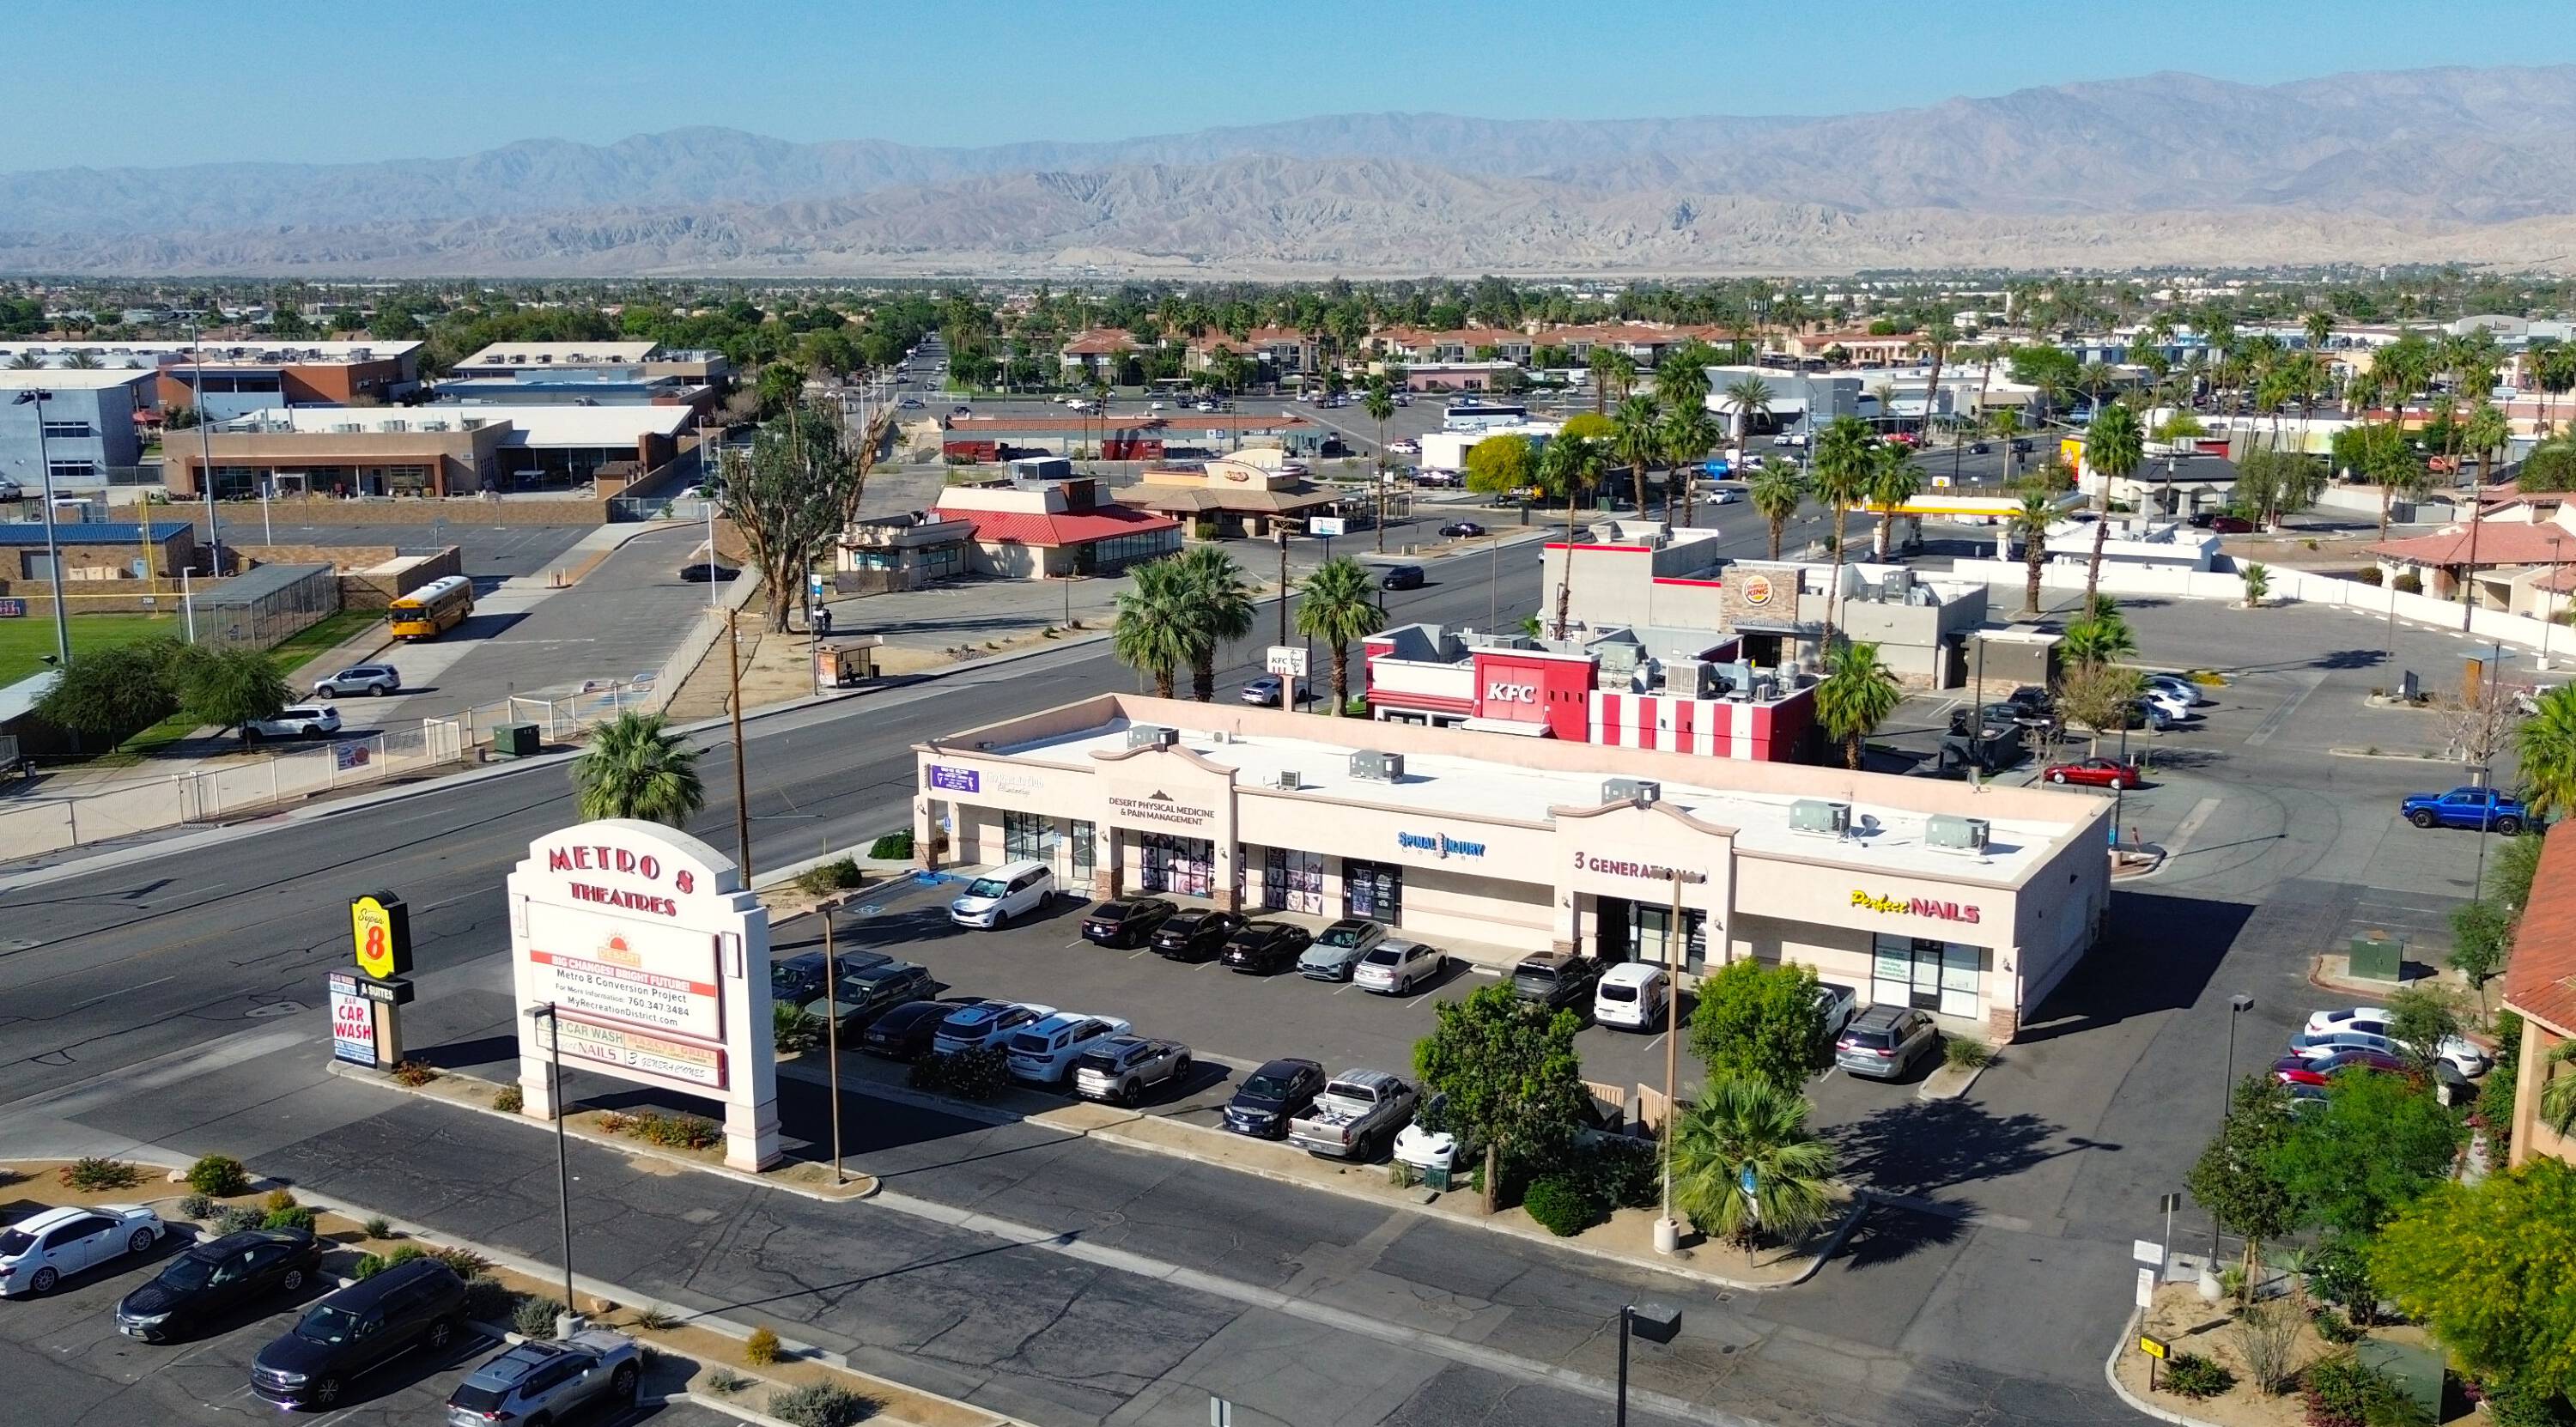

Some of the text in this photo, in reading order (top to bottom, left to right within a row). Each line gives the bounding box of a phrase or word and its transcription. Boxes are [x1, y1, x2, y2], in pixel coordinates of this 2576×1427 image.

[1487, 683, 1536, 704] KFC
[1109, 797, 1215, 818] DESERT PHYSICAL MEDICINE
[1127, 809, 1145, 818] PAIN
[1146, 811, 1203, 825] MANAGEMENT
[1398, 831, 1436, 850] SPINAL
[1443, 837, 1485, 857] INJURY
[550, 846, 694, 895] METRO 8
[1574, 851, 1585, 870] 3
[568, 881, 677, 917] THEATRES
[1850, 890, 1980, 924] Perfect NAILS
[358, 908, 384, 928] Super
[366, 926, 386, 961] 8
[551, 955, 690, 992] BIG CHANGES! BRIGHT FUTURE!
[361, 982, 368, 995] &
[368, 986, 394, 1001] SUITES
[557, 969, 687, 1004] Metro 8 Conversion Project
[338, 1005, 364, 1022] CAR
[568, 996, 678, 1026] MyRecreationDistrict.com
[628, 997, 690, 1017] 760.347.3484
[334, 1022, 371, 1040] WASH
[567, 1022, 588, 1036] CAR
[591, 1028, 623, 1044] WASH
[578, 1041, 617, 1060] NAILS
[628, 1052, 637, 1066] 3
